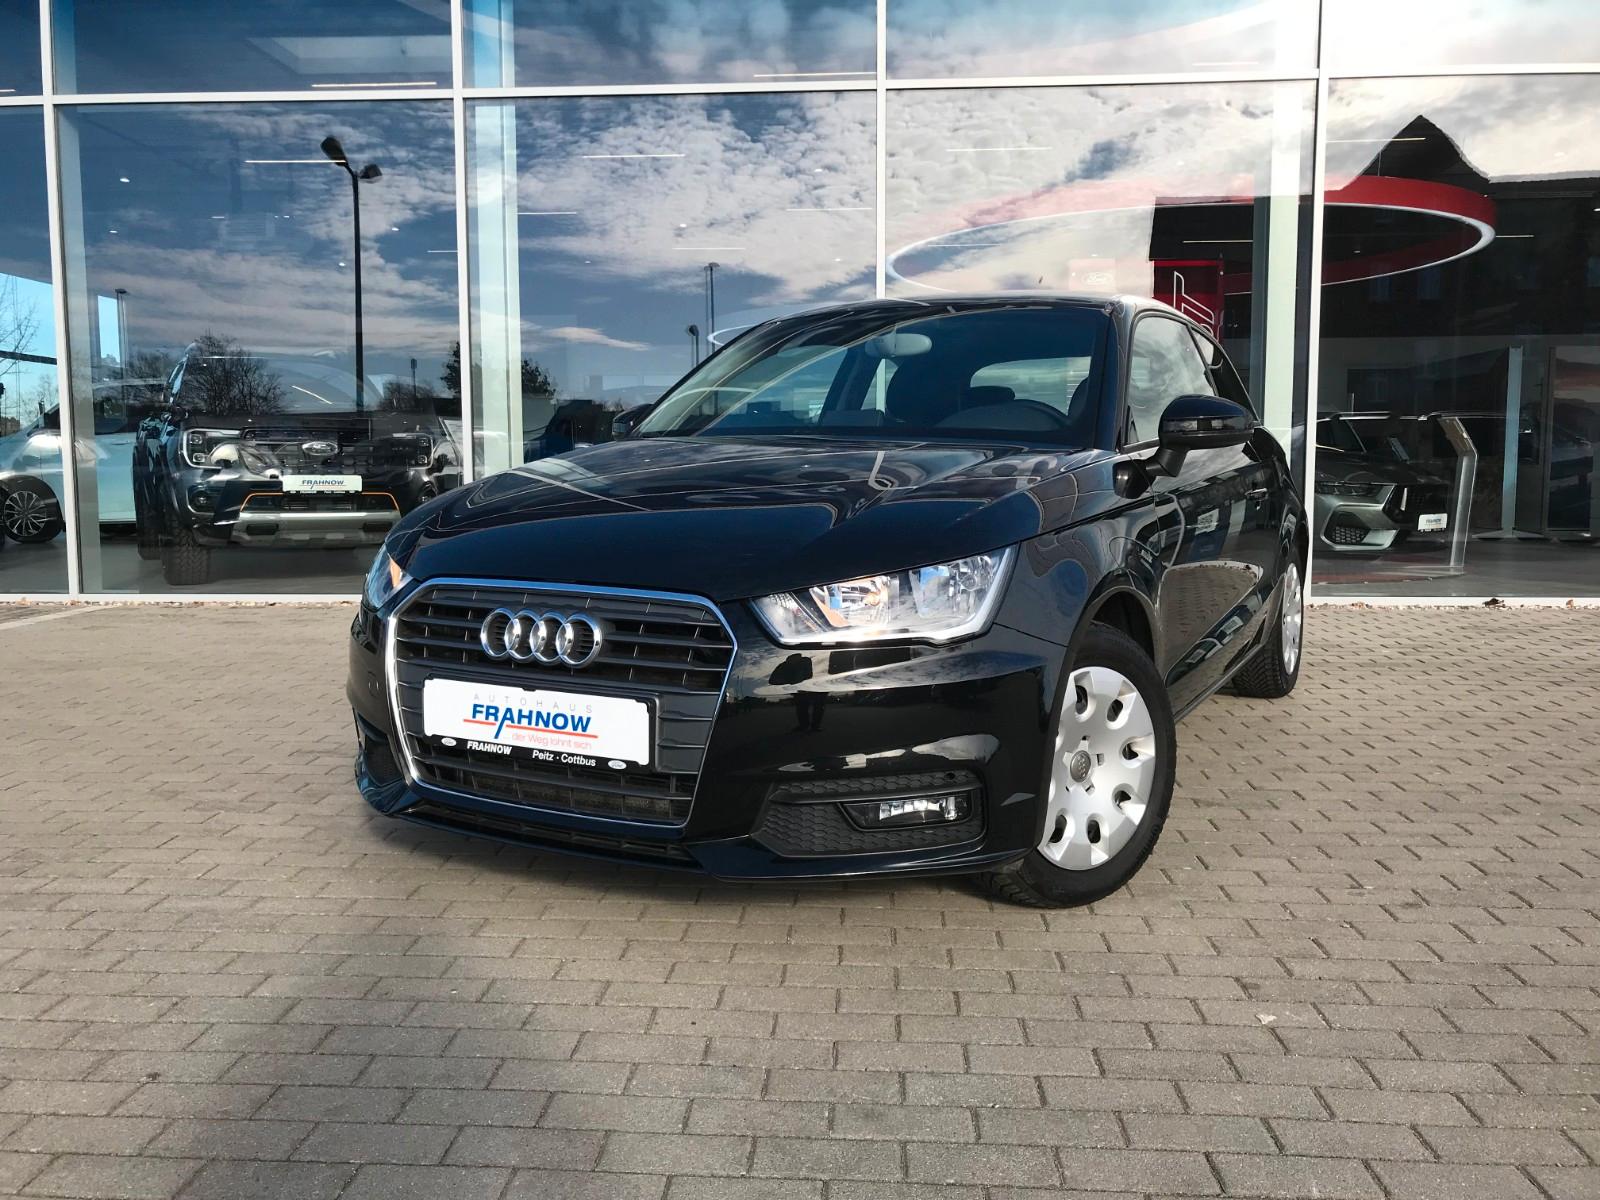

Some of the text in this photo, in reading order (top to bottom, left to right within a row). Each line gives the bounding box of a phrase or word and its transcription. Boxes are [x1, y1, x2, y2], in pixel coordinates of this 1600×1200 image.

[473, 693, 593, 713] AUTOHAUS
[471, 703, 592, 739] FRAHNOW
[467, 741, 512, 755] FRAHNOW
[528, 734, 549, 746] Weg
[550, 736, 572, 748] lohnt
[532, 750, 554, 761] Peitz
[561, 754, 597, 766] Cottbus
